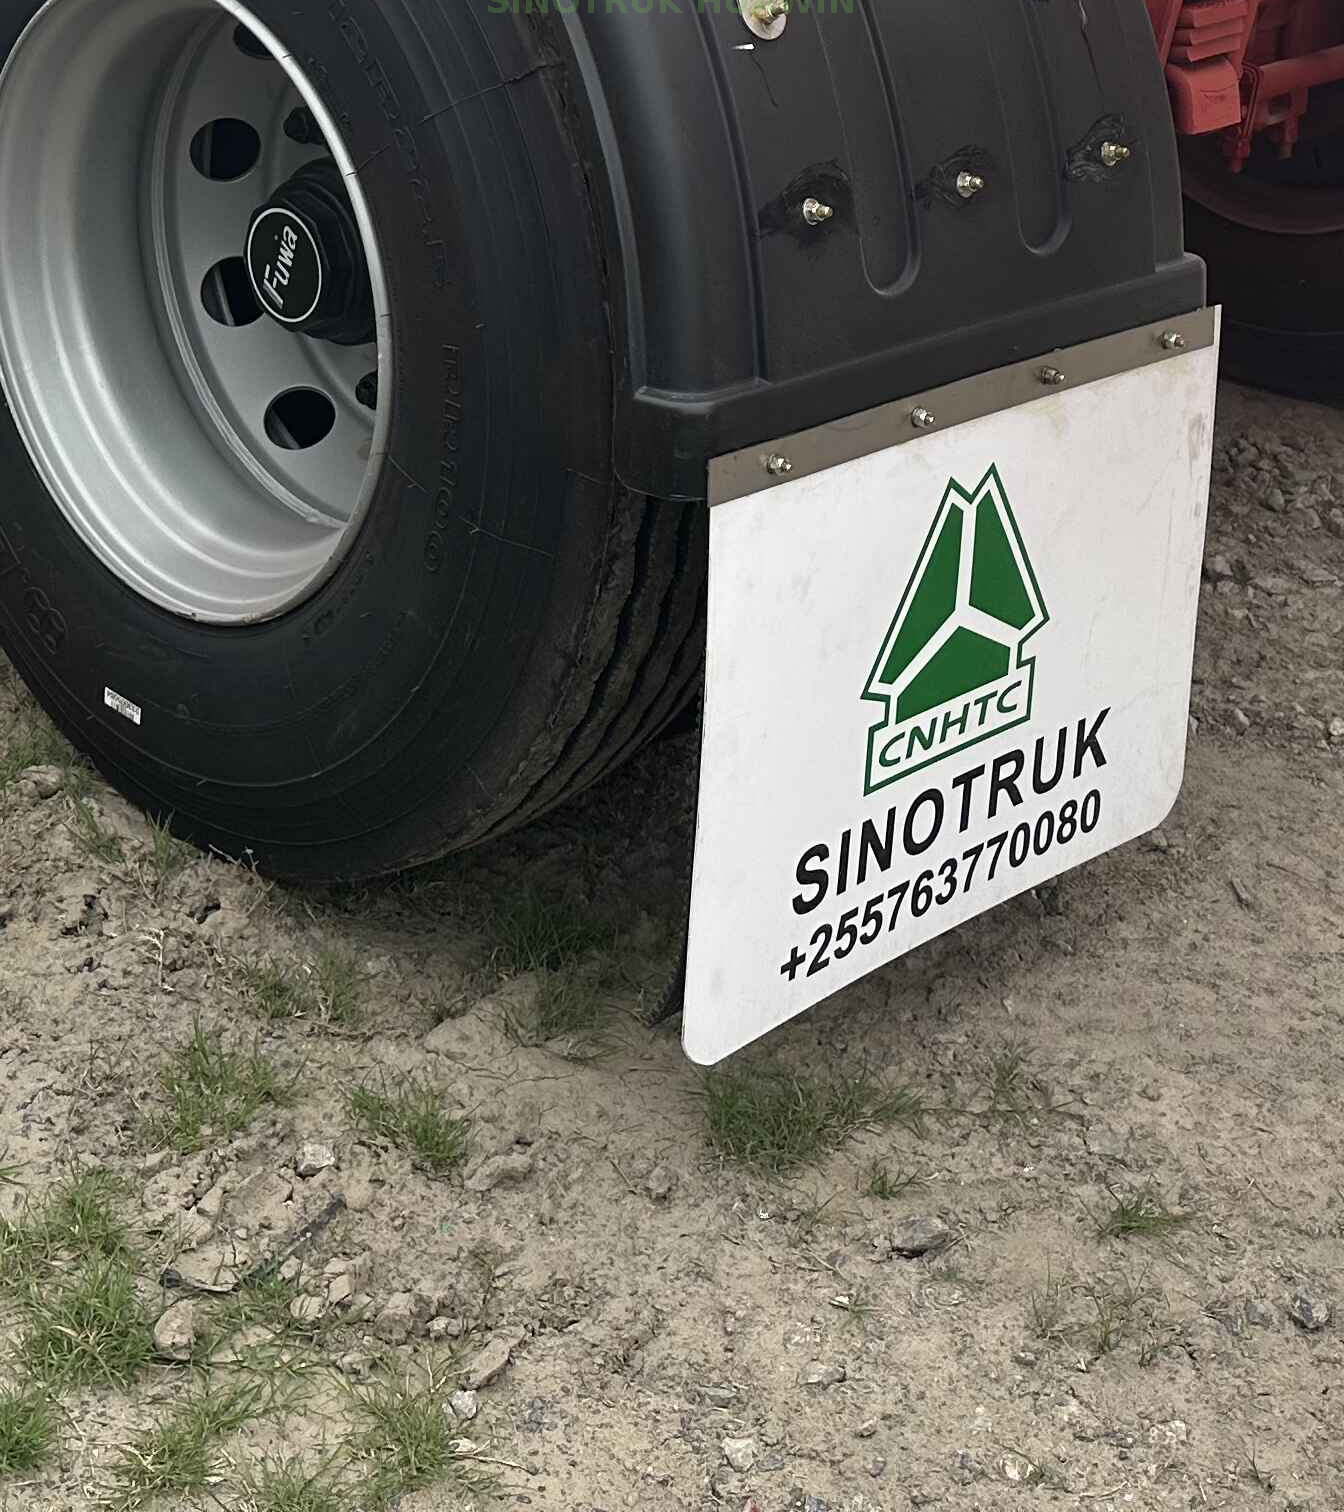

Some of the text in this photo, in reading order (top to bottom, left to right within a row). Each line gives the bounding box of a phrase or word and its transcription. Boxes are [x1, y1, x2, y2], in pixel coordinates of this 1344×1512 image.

[262, 225, 298, 309] Fuwa
[877, 678, 1022, 768] CNHTC
[791, 707, 1112, 916] SINOTRUK
[779, 788, 1103, 982] +255763770080
